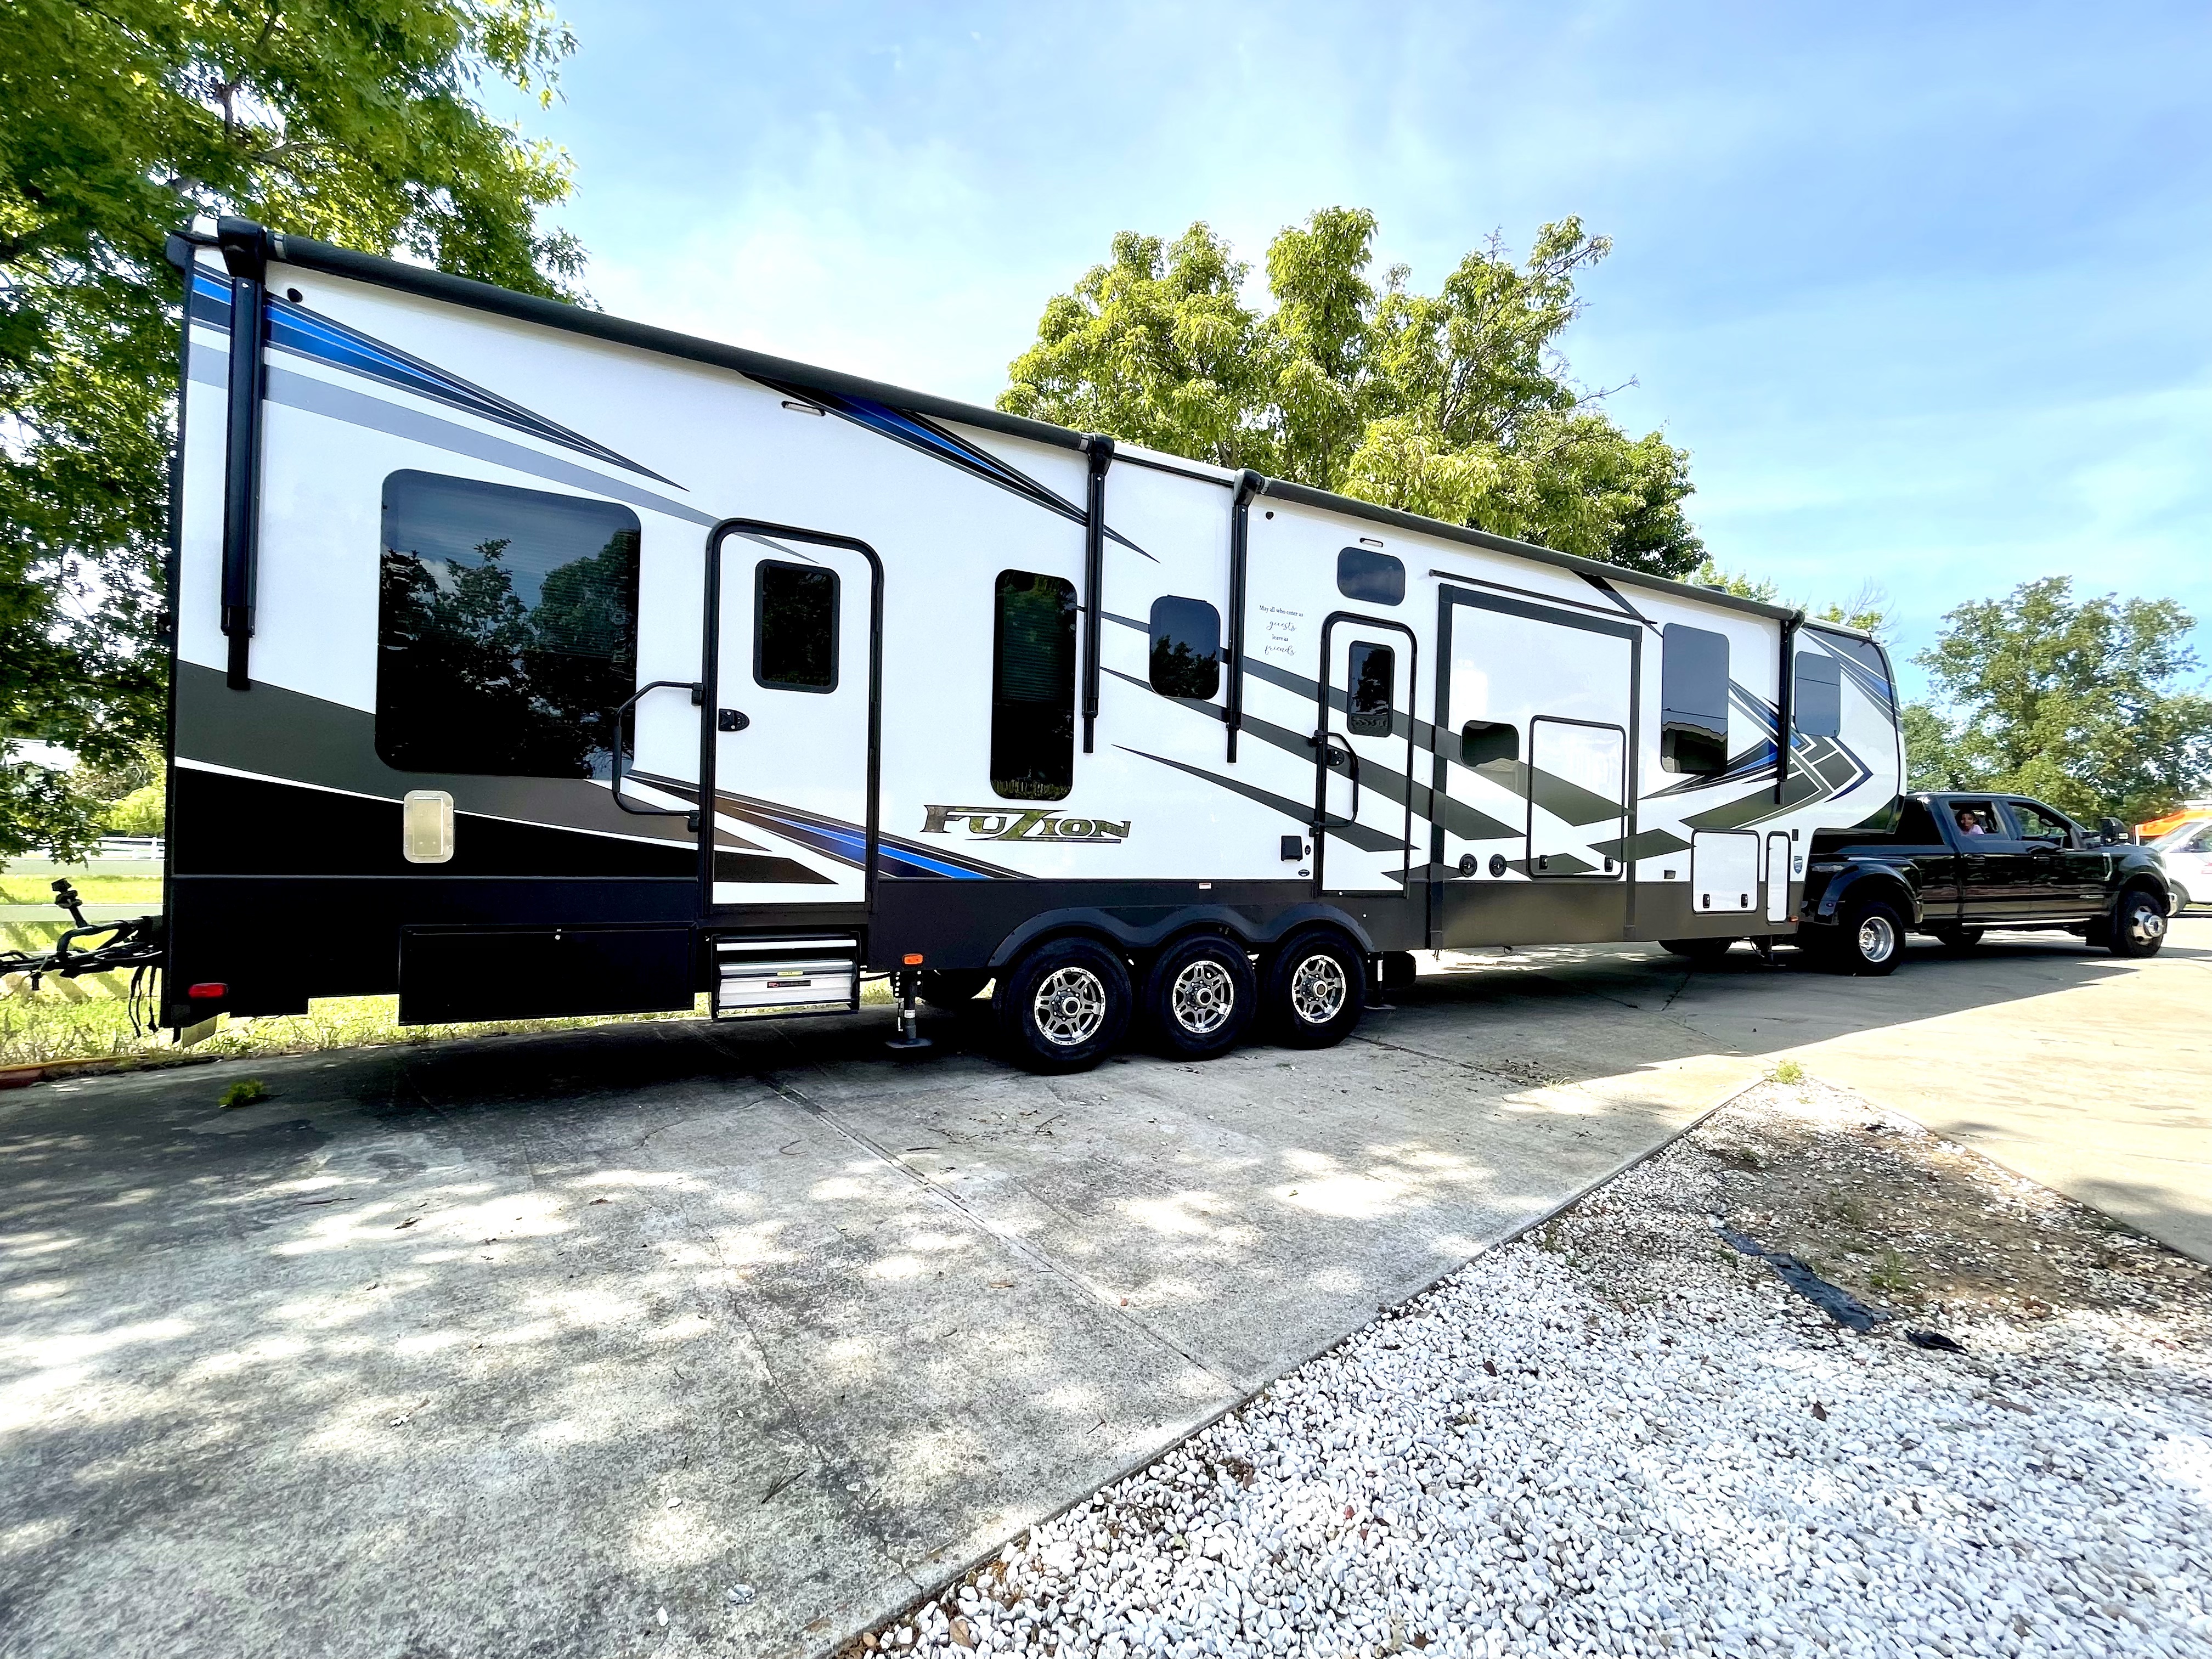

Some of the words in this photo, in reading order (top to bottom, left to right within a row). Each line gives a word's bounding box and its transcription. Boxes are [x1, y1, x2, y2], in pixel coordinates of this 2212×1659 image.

[1260, 605, 1268, 613] May
[1266, 622, 1297, 631] guests
[1265, 645, 1296, 656] friends
[919, 805, 1131, 844] FUZION
